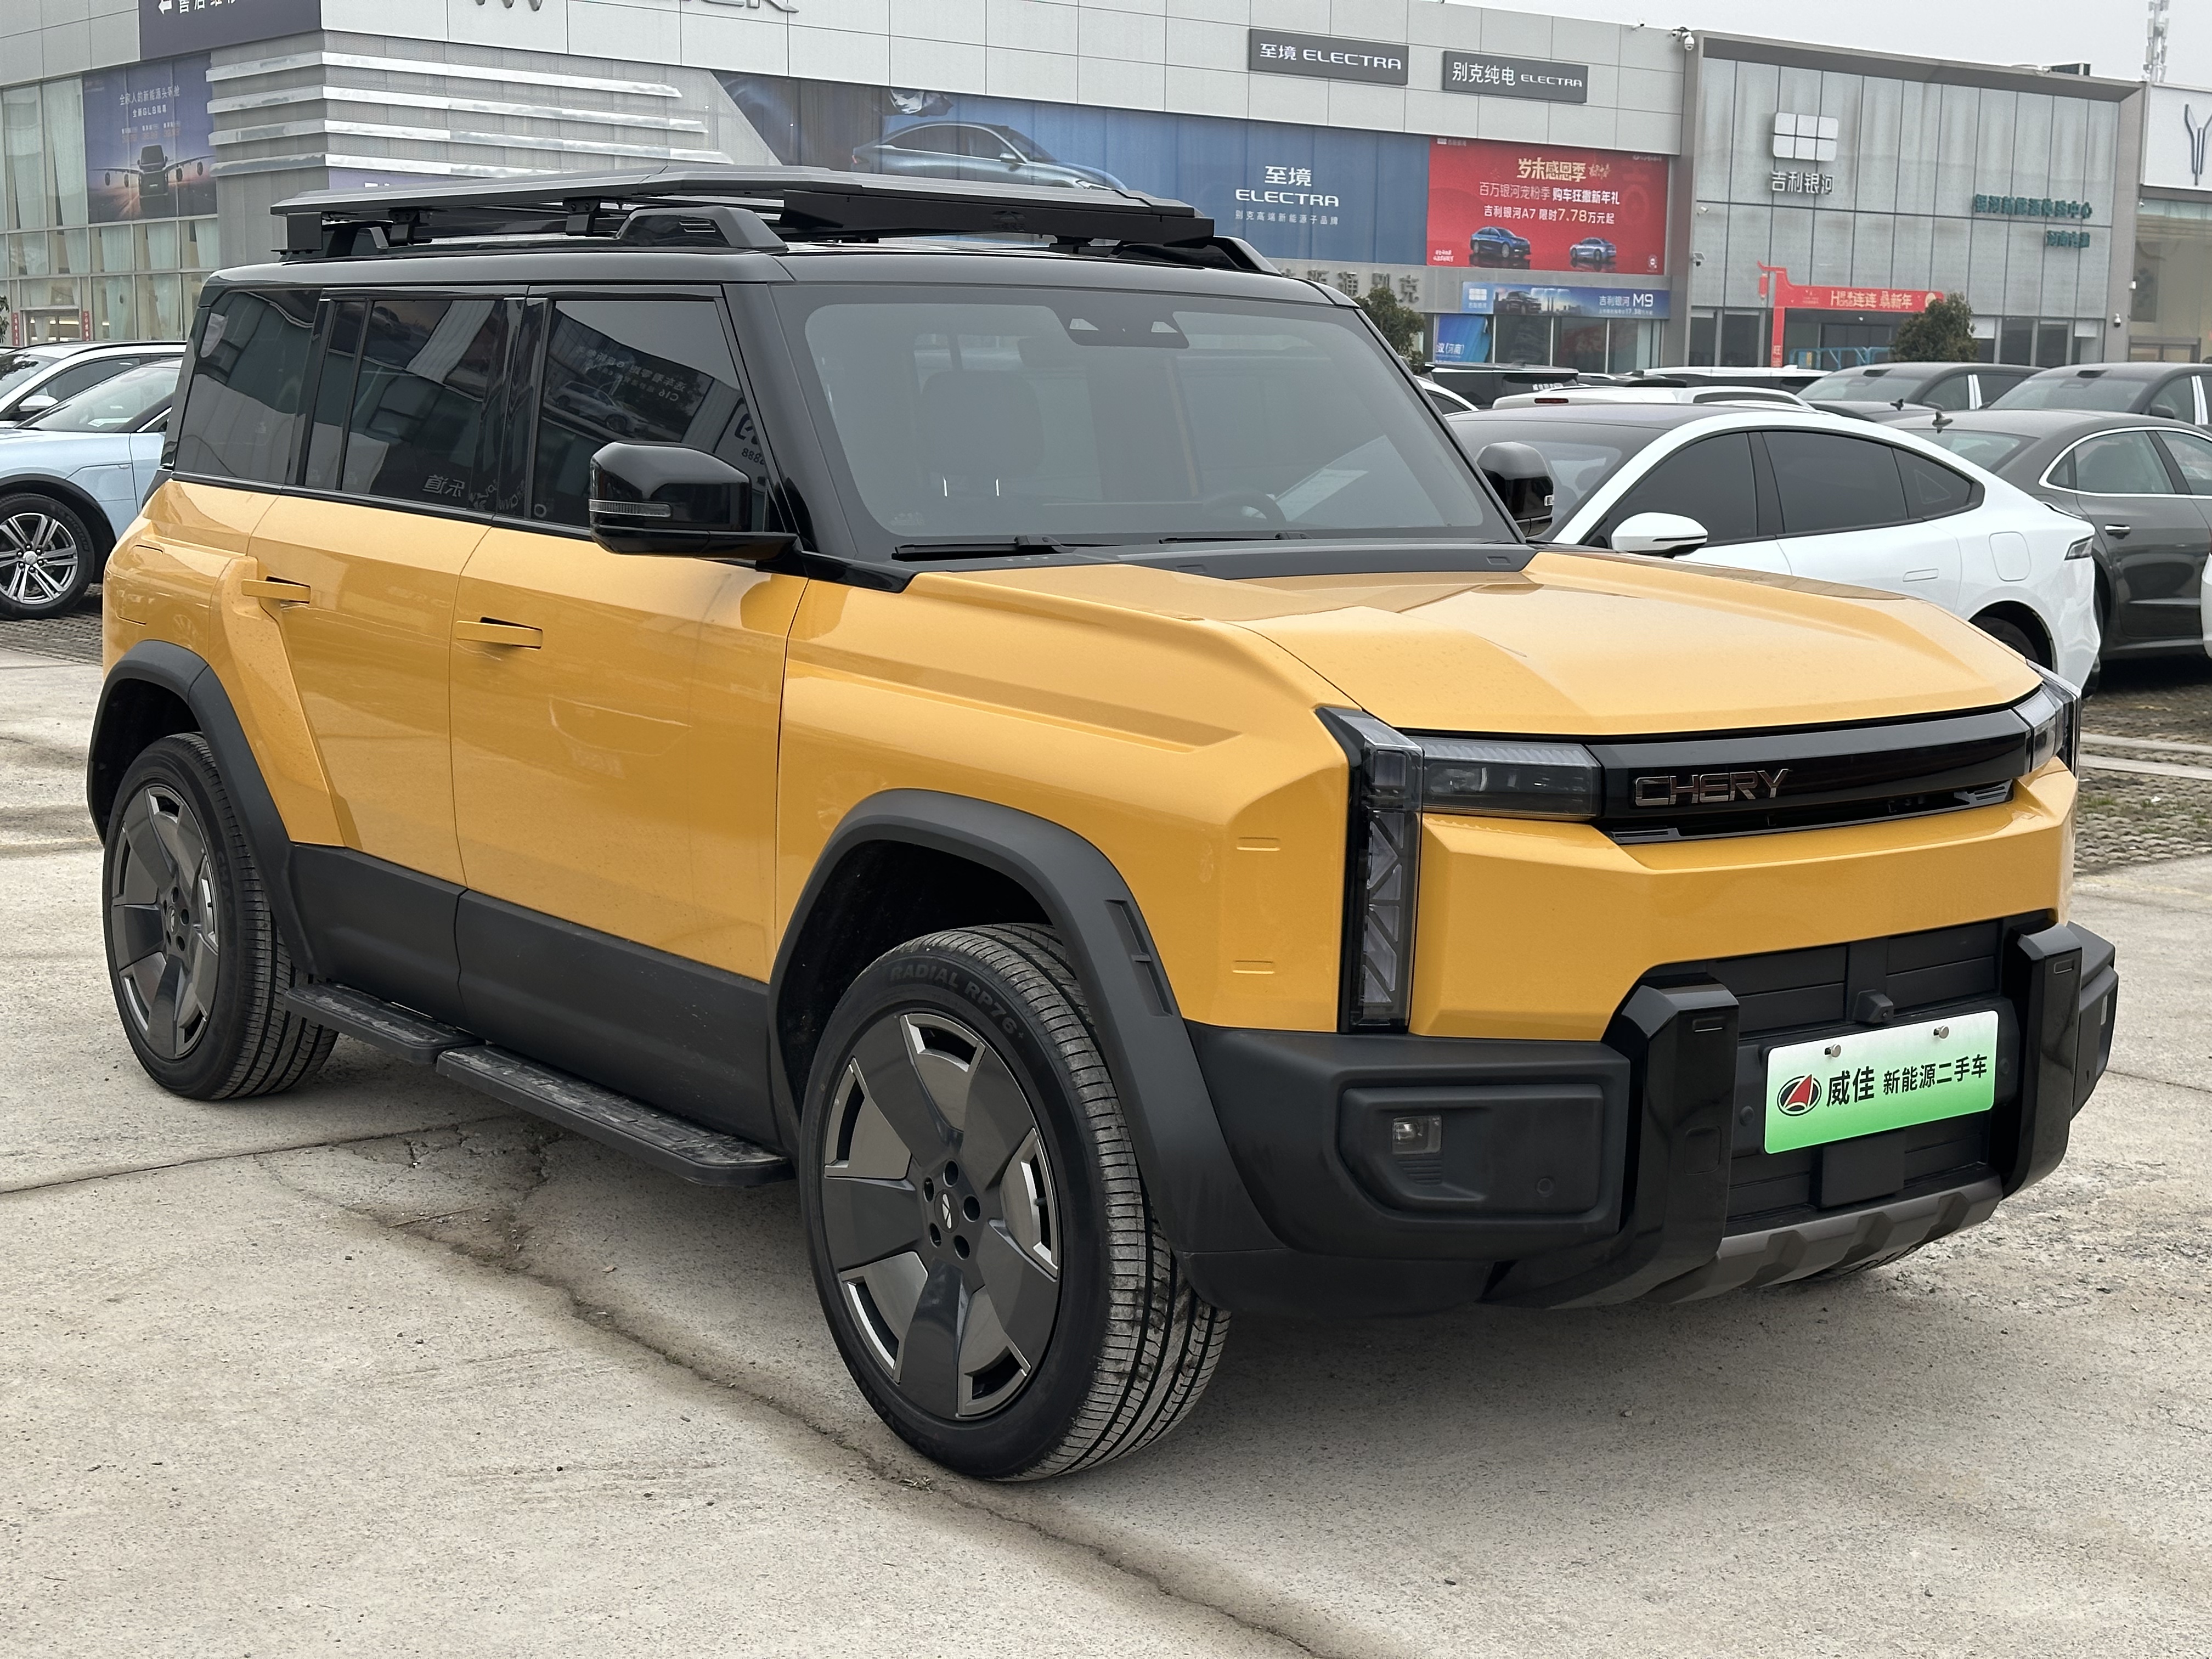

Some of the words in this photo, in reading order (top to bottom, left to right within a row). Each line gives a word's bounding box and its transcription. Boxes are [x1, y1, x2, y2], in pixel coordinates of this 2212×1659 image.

[1260, 43, 1297, 60] 至境
[1302, 49, 1402, 70] ELECTRA
[1452, 61, 1516, 86] 别克纯电
[1521, 74, 1583, 88] ELECTRA
[1264, 165, 1312, 187] 至境
[1516, 157, 1587, 182] 岁末感恩季
[1479, 182, 1550, 201] 百万银河宠粉季
[1772, 171, 1835, 194] 吉利银河
[1235, 189, 1339, 207] ELECTRA
[1235, 210, 1339, 225] 别克高端新能源子品牌
[1484, 205, 1536, 219] 吉利银河A7
[1539, 208, 1615, 224] 限时7.78万元起
[1599, 295, 1630, 307] 吉利银河
[1633, 293, 1654, 307] M9
[1634, 768, 1790, 806] CHERY
[889, 964, 959, 989] RADIAL
[1826, 1065, 1875, 1108] 威佳
[1882, 1053, 1988, 1096] 新能源二手车
